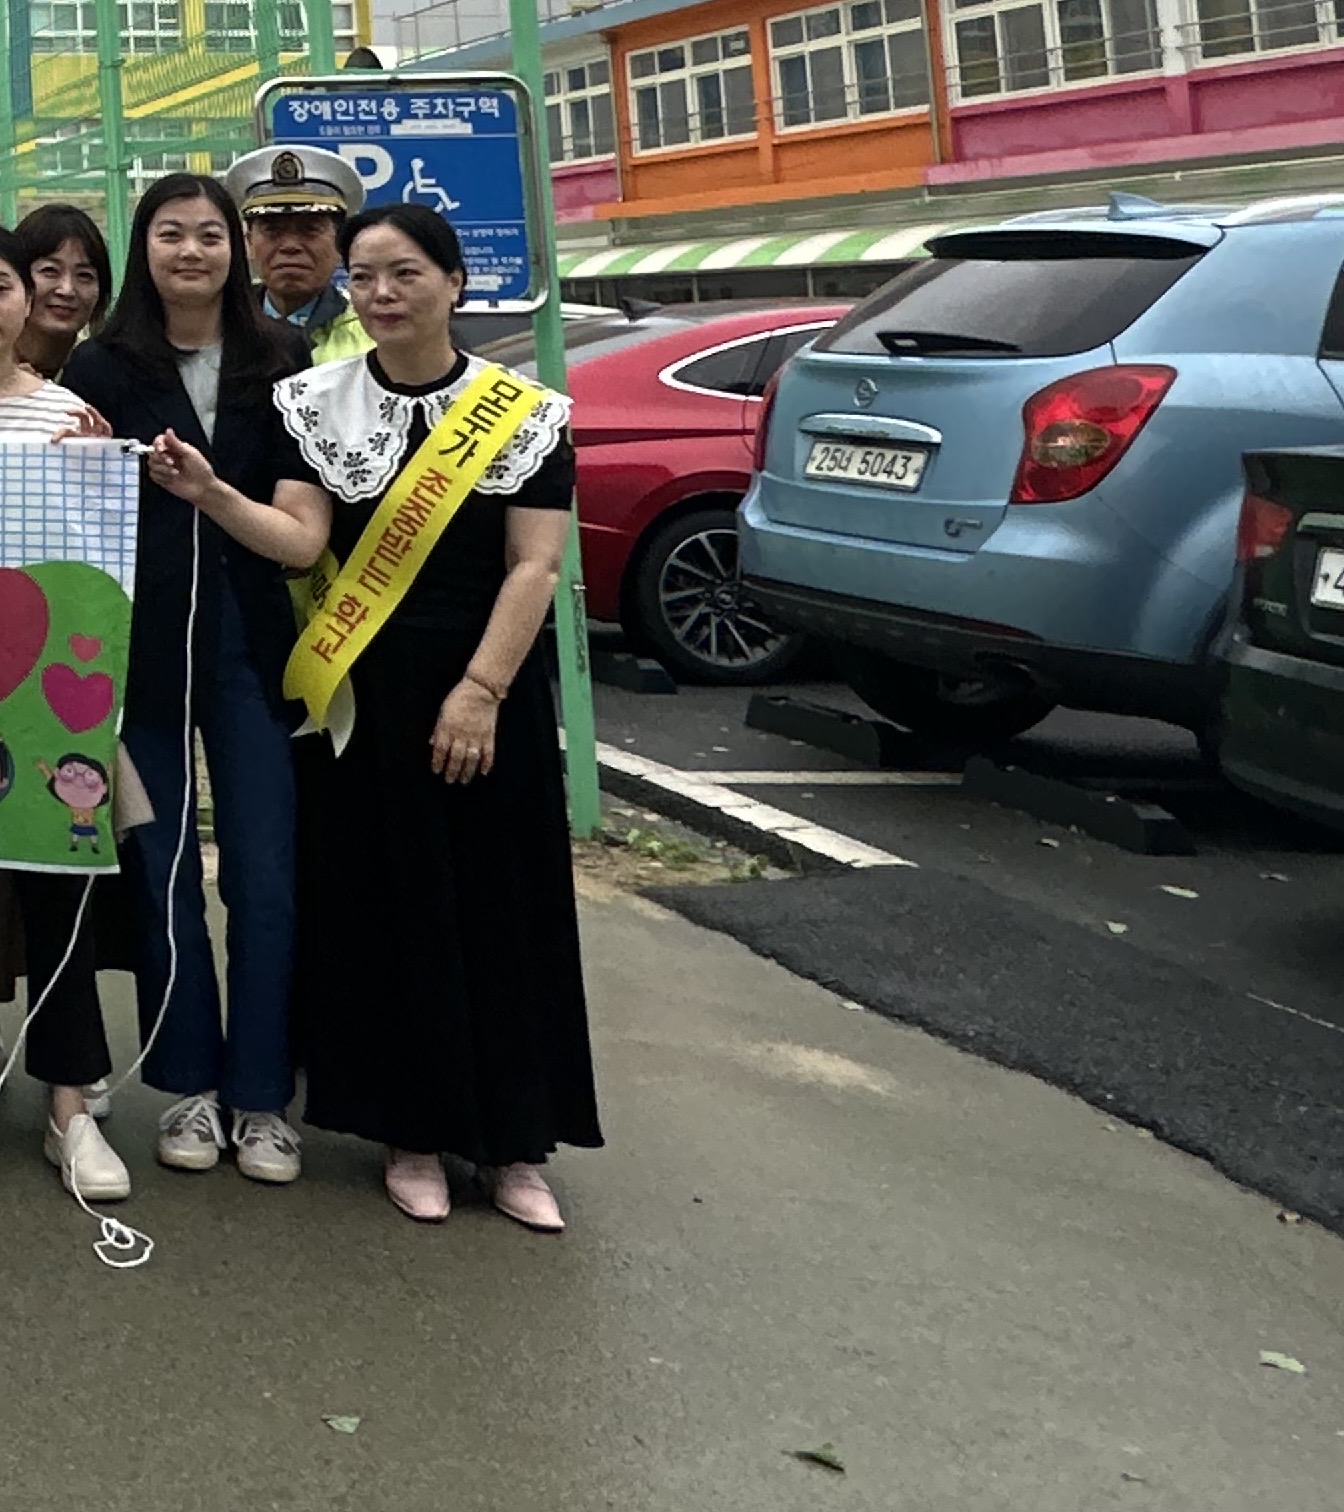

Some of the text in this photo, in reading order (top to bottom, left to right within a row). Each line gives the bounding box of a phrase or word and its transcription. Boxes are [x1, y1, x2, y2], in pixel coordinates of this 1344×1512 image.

[288, 96, 500, 123] 장애인전용 주차구역
[438, 379, 524, 469] 모두가
[856, 450, 912, 480] 5043
[356, 466, 454, 598] 존중받는
[311, 593, 370, 665] 학교
